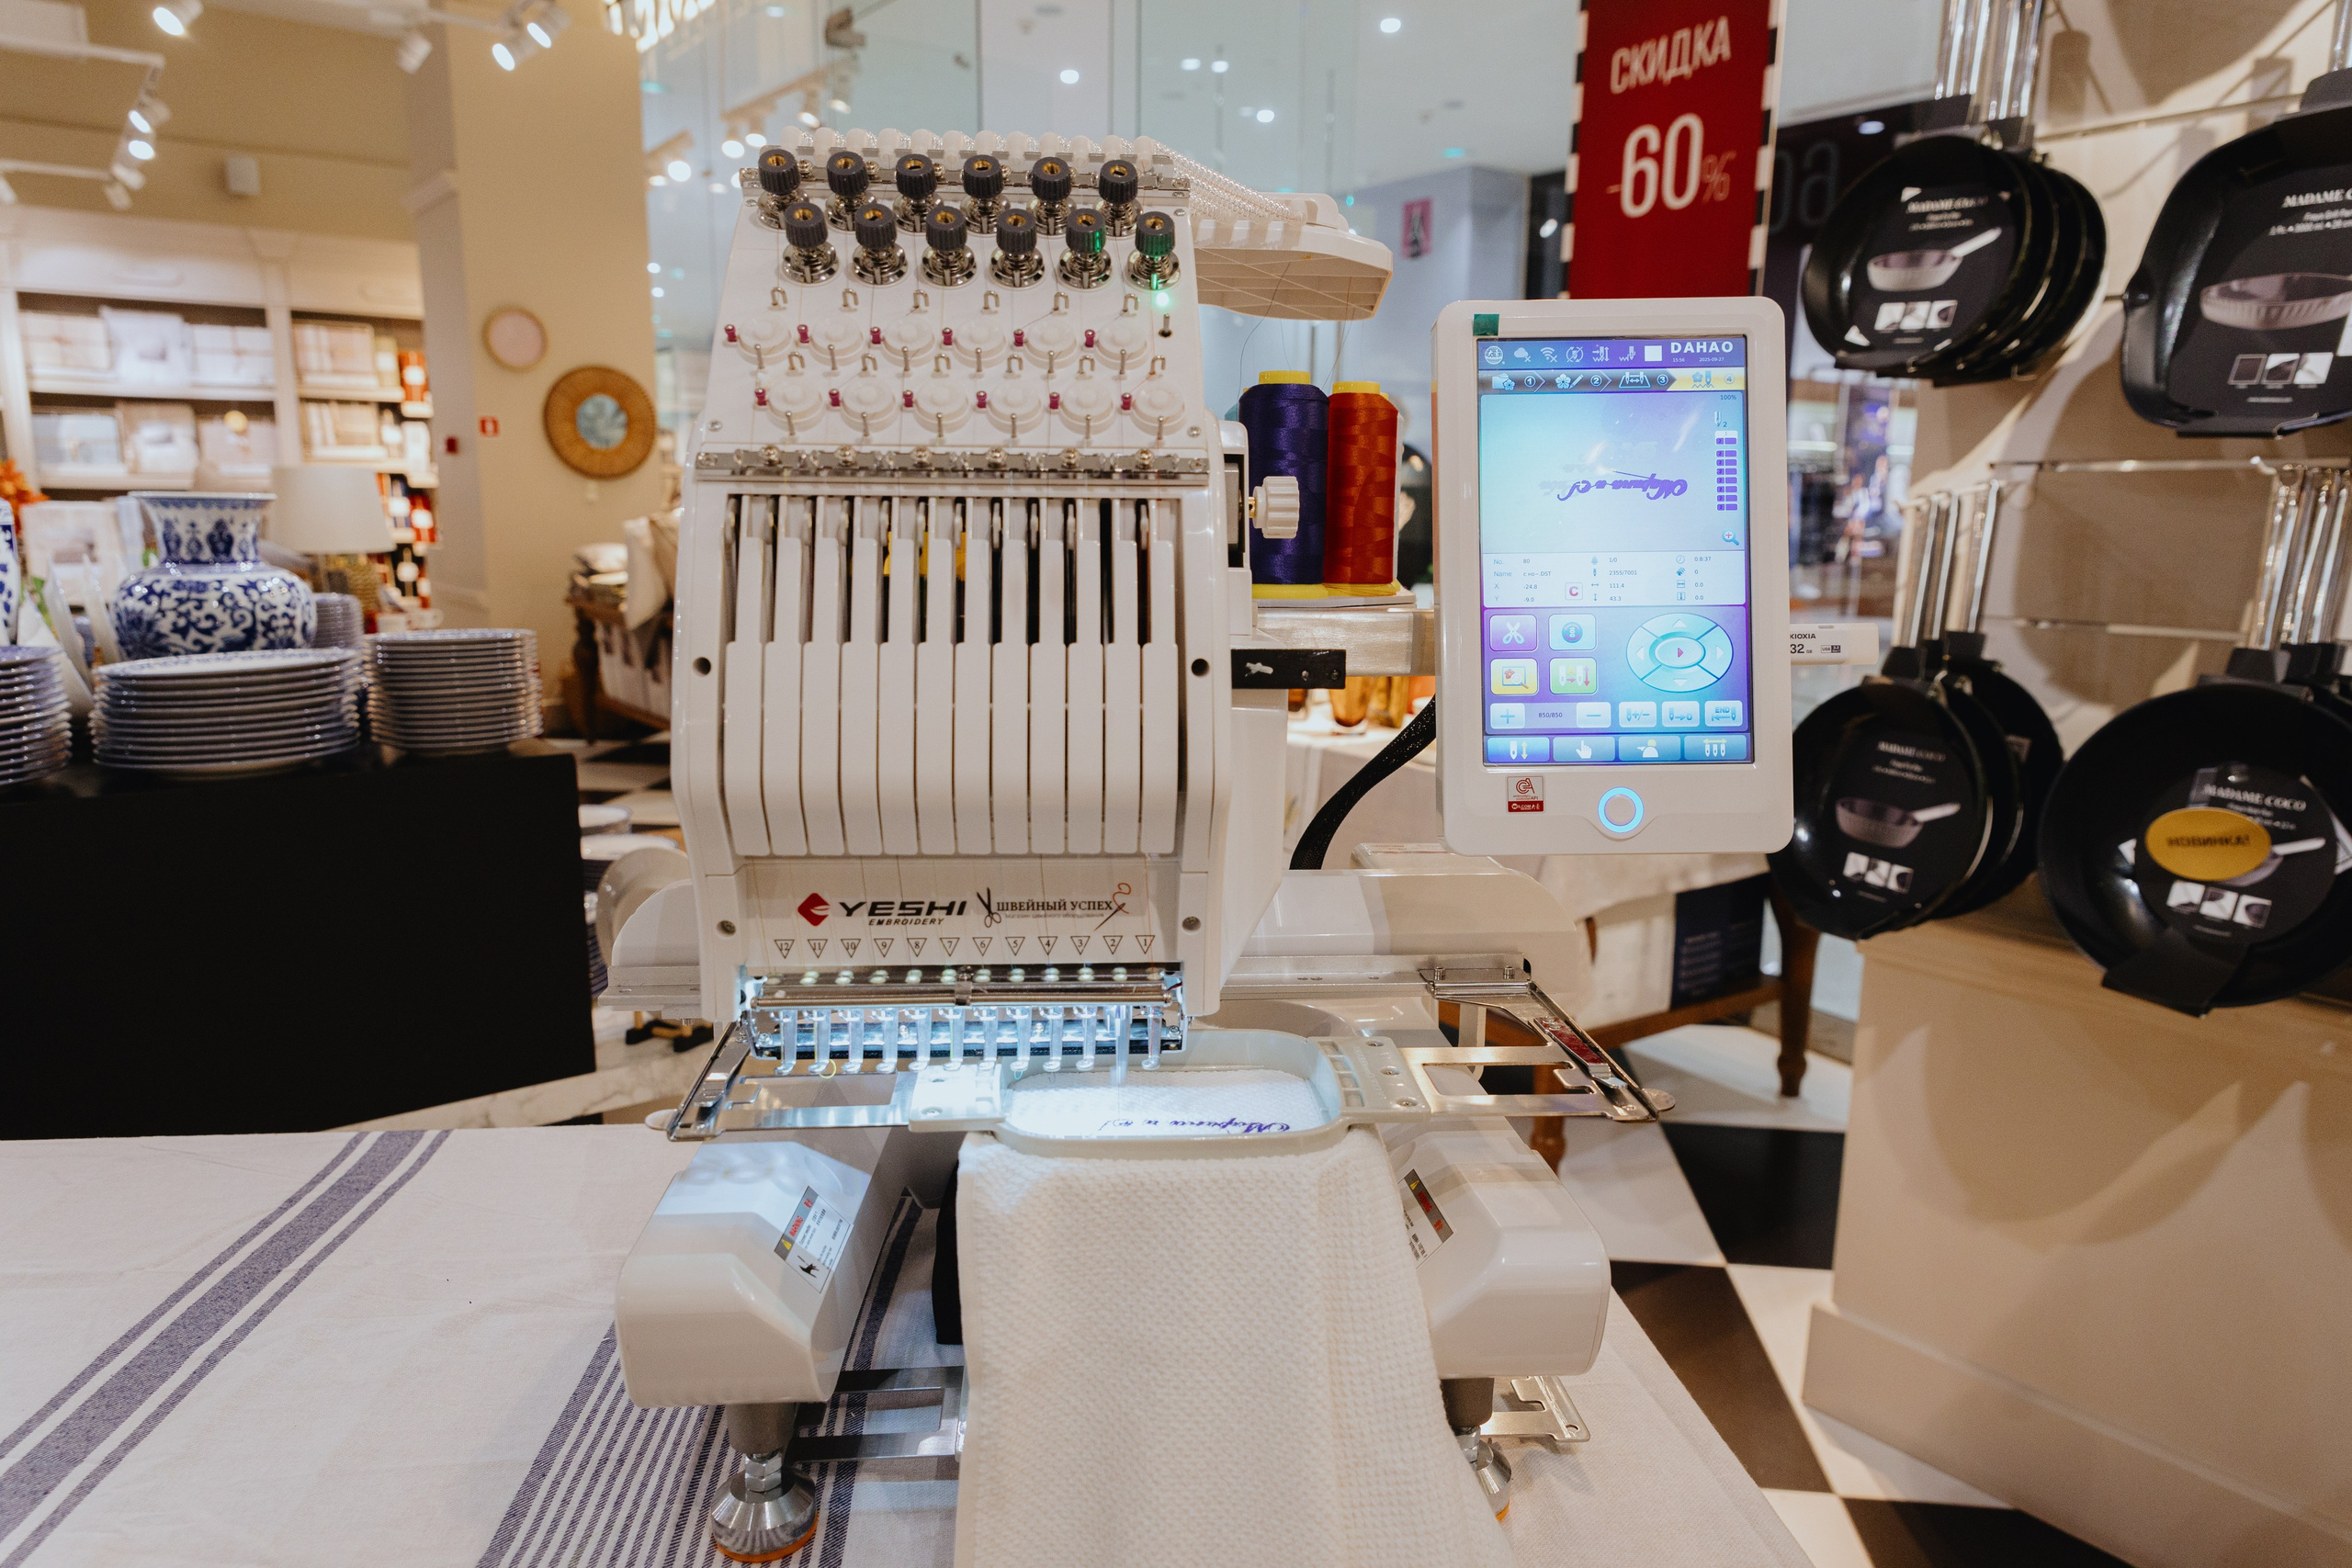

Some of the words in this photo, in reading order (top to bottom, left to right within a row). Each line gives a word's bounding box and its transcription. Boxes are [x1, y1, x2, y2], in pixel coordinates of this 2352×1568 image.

[1610, 16, 1732, 94] СКИДКА
[2282, 188, 2345, 209] MADAME
[1670, 341, 1734, 355] DAHAO
[1568, 586, 1579, 597] C
[1790, 643, 1804, 654] 32
[2204, 784, 2265, 805] MADAME
[2264, 795, 2307, 813] COCO
[838, 900, 967, 917] YESHI
[997, 898, 1068, 912] ШВЕЙНЫЙ
[1069, 900, 1114, 911] УСПЕХ
[868, 918, 944, 926] EMBROIDERY
[780, 942, 789, 951] 12
[812, 942, 821, 951] 11
[845, 942, 856, 951] 10
[881, 942, 887, 950] 9
[947, 941, 953, 949] 7
[979, 940, 986, 948] 6
[1012, 940, 1018, 948] 5
[1045, 940, 1050, 948] 4
[1110, 939, 1116, 947] 2
